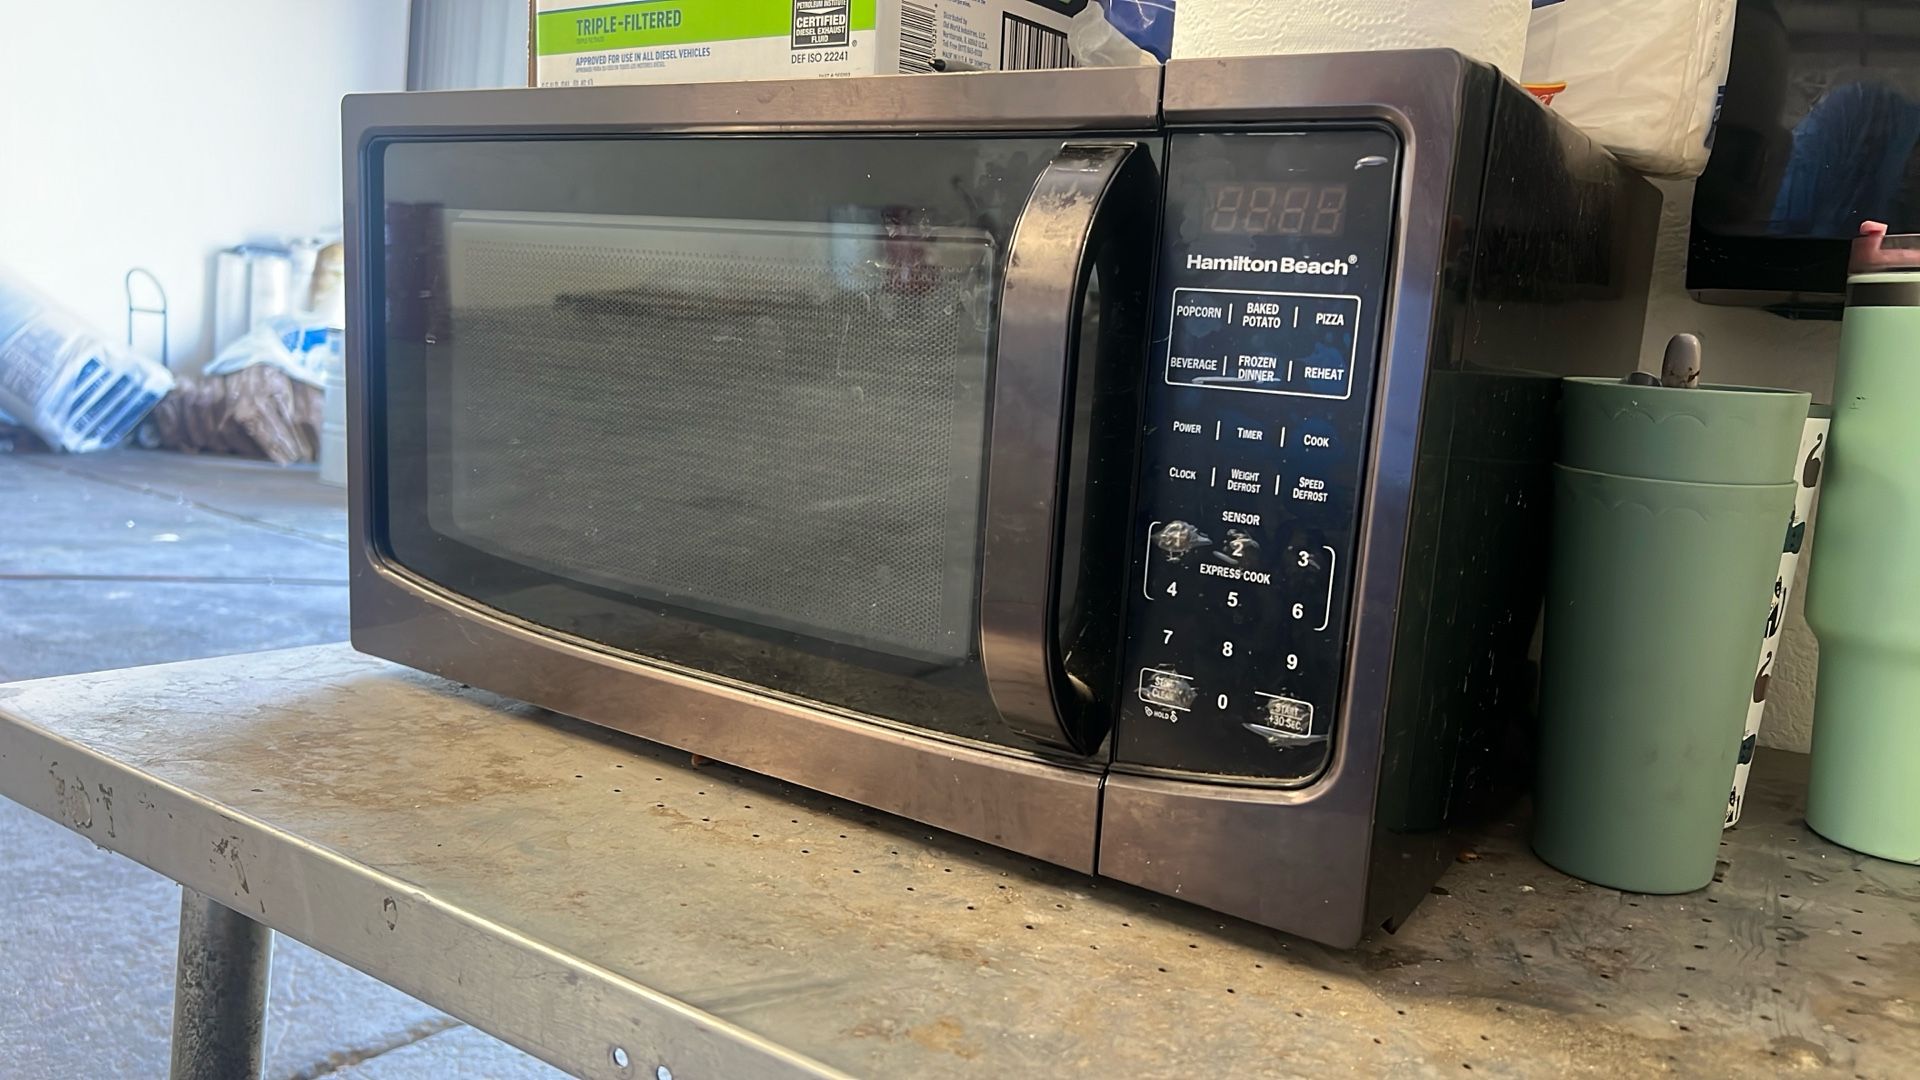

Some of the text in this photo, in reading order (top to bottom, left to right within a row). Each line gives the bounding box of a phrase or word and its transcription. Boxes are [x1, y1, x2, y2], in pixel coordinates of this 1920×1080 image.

[576, 9, 682, 36] TRIPLE-FILTERED
[796, 14, 846, 28] CERTIFIED
[796, 26, 845, 37] DIESEL EXHAUST
[811, 34, 829, 43] FLUID
[575, 47, 710, 66] APPROVED FOR USE IN ALL DIESEL VEHICLES
[791, 51, 848, 64] DEF ISO 22241
[1186, 254, 1349, 276] Hamilton Beach
[1176, 305, 1222, 319] POPCORN
[1246, 302, 1280, 316] BAKED
[1242, 315, 1281, 329] POTATO
[1315, 312, 1345, 326] PIZZA
[1170, 356, 1218, 371] BEVERAGE
[1238, 355, 1277, 369] FROZEN
[1237, 368, 1275, 382] DINNER
[1304, 366, 1345, 381] REHEAT
[1173, 421, 1202, 434] POWER
[1236, 427, 1263, 441] TIMER
[1303, 434, 1330, 448] COOK
[1169, 466, 1197, 480] CLOCK
[1231, 468, 1260, 482] WEIGHT
[1227, 480, 1262, 494] DEFROST
[1299, 476, 1325, 490] SPEED
[1292, 488, 1329, 503] DEFROST
[1222, 510, 1261, 526] SENSOR
[1231, 542, 1243, 557] 2
[1297, 550, 1310, 567] 3
[1199, 563, 1271, 585] EXPRESS COOK
[1166, 581, 1178, 597] 4
[1227, 591, 1239, 607] 5
[1292, 603, 1304, 619] 6
[1163, 629, 1174, 644] 7
[1222, 641, 1233, 657] 8
[1286, 654, 1298, 670] 9
[1217, 694, 1228, 710] 0
[1153, 710, 1170, 720] HOLD
[1274, 703, 1299, 717] START
[1269, 713, 1285, 727] +30
